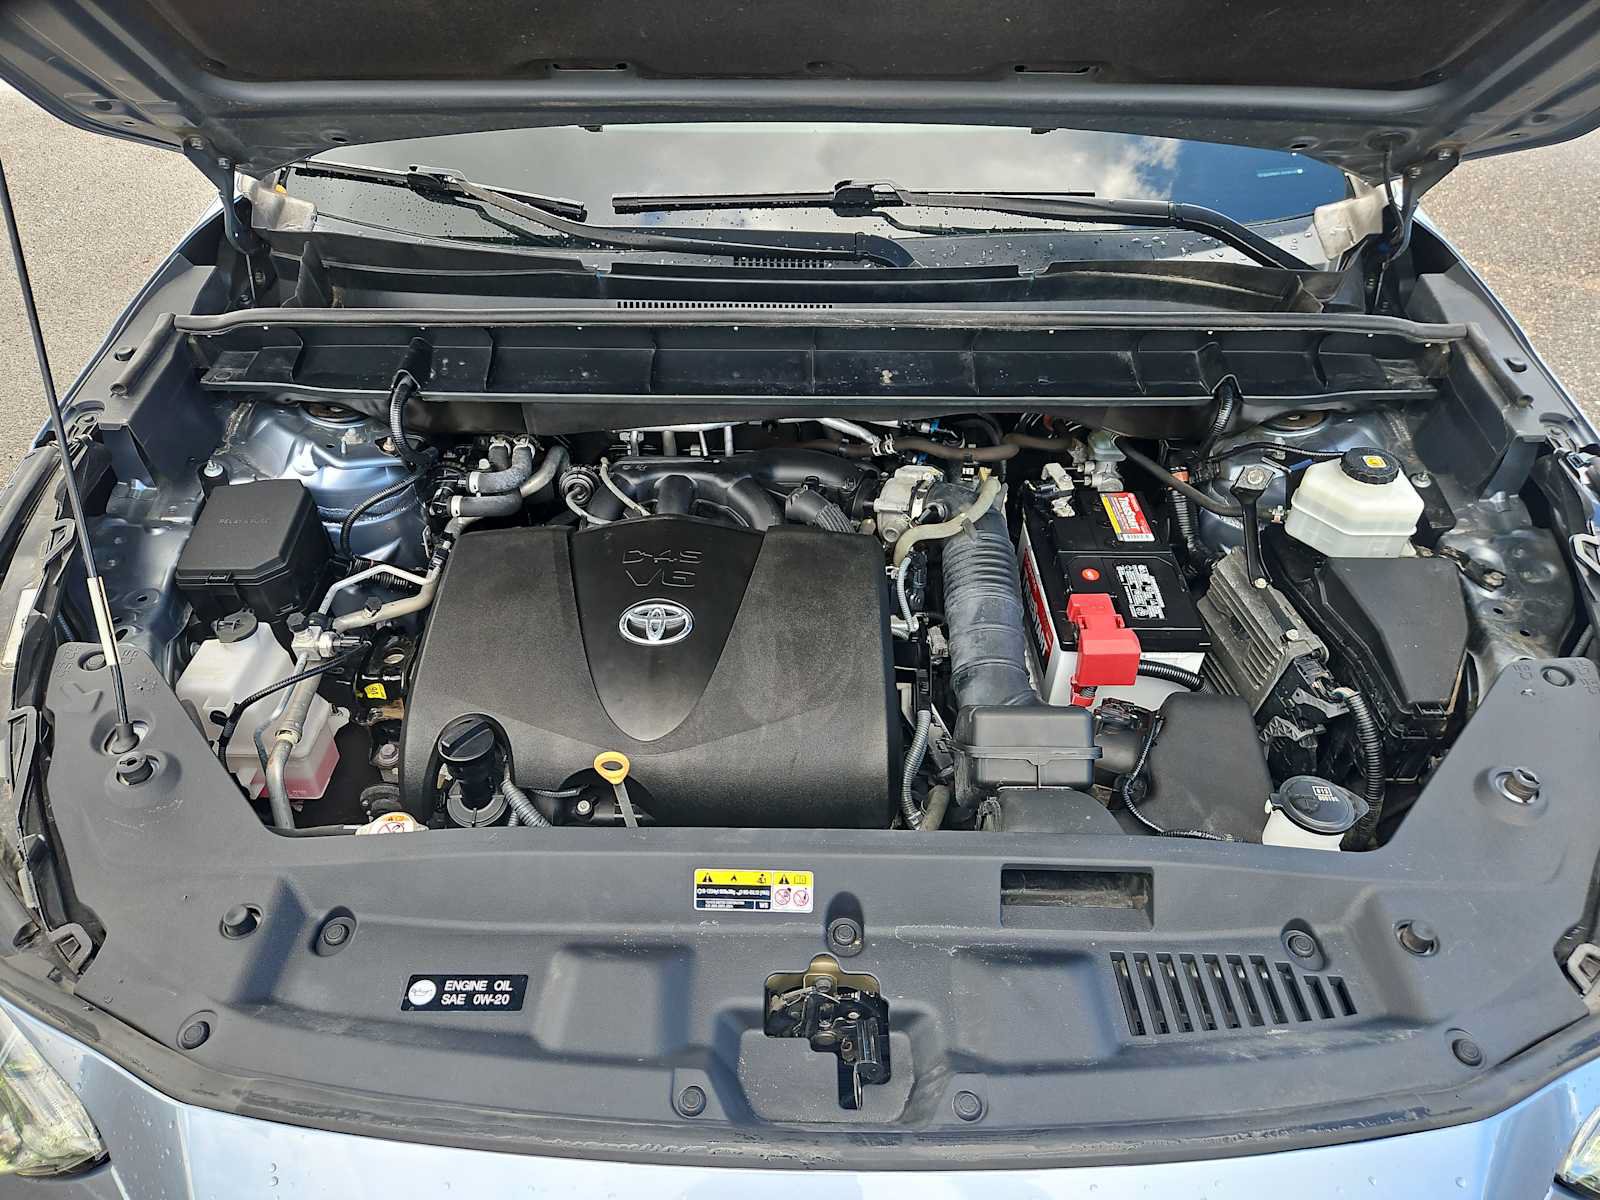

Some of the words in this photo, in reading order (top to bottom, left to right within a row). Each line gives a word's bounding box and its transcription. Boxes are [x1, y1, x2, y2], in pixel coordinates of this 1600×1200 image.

[444, 980, 488, 991] ENGINE
[493, 980, 513, 991] OIL
[440, 994, 466, 1006] SAE
[472, 994, 510, 1006] 0W-20
